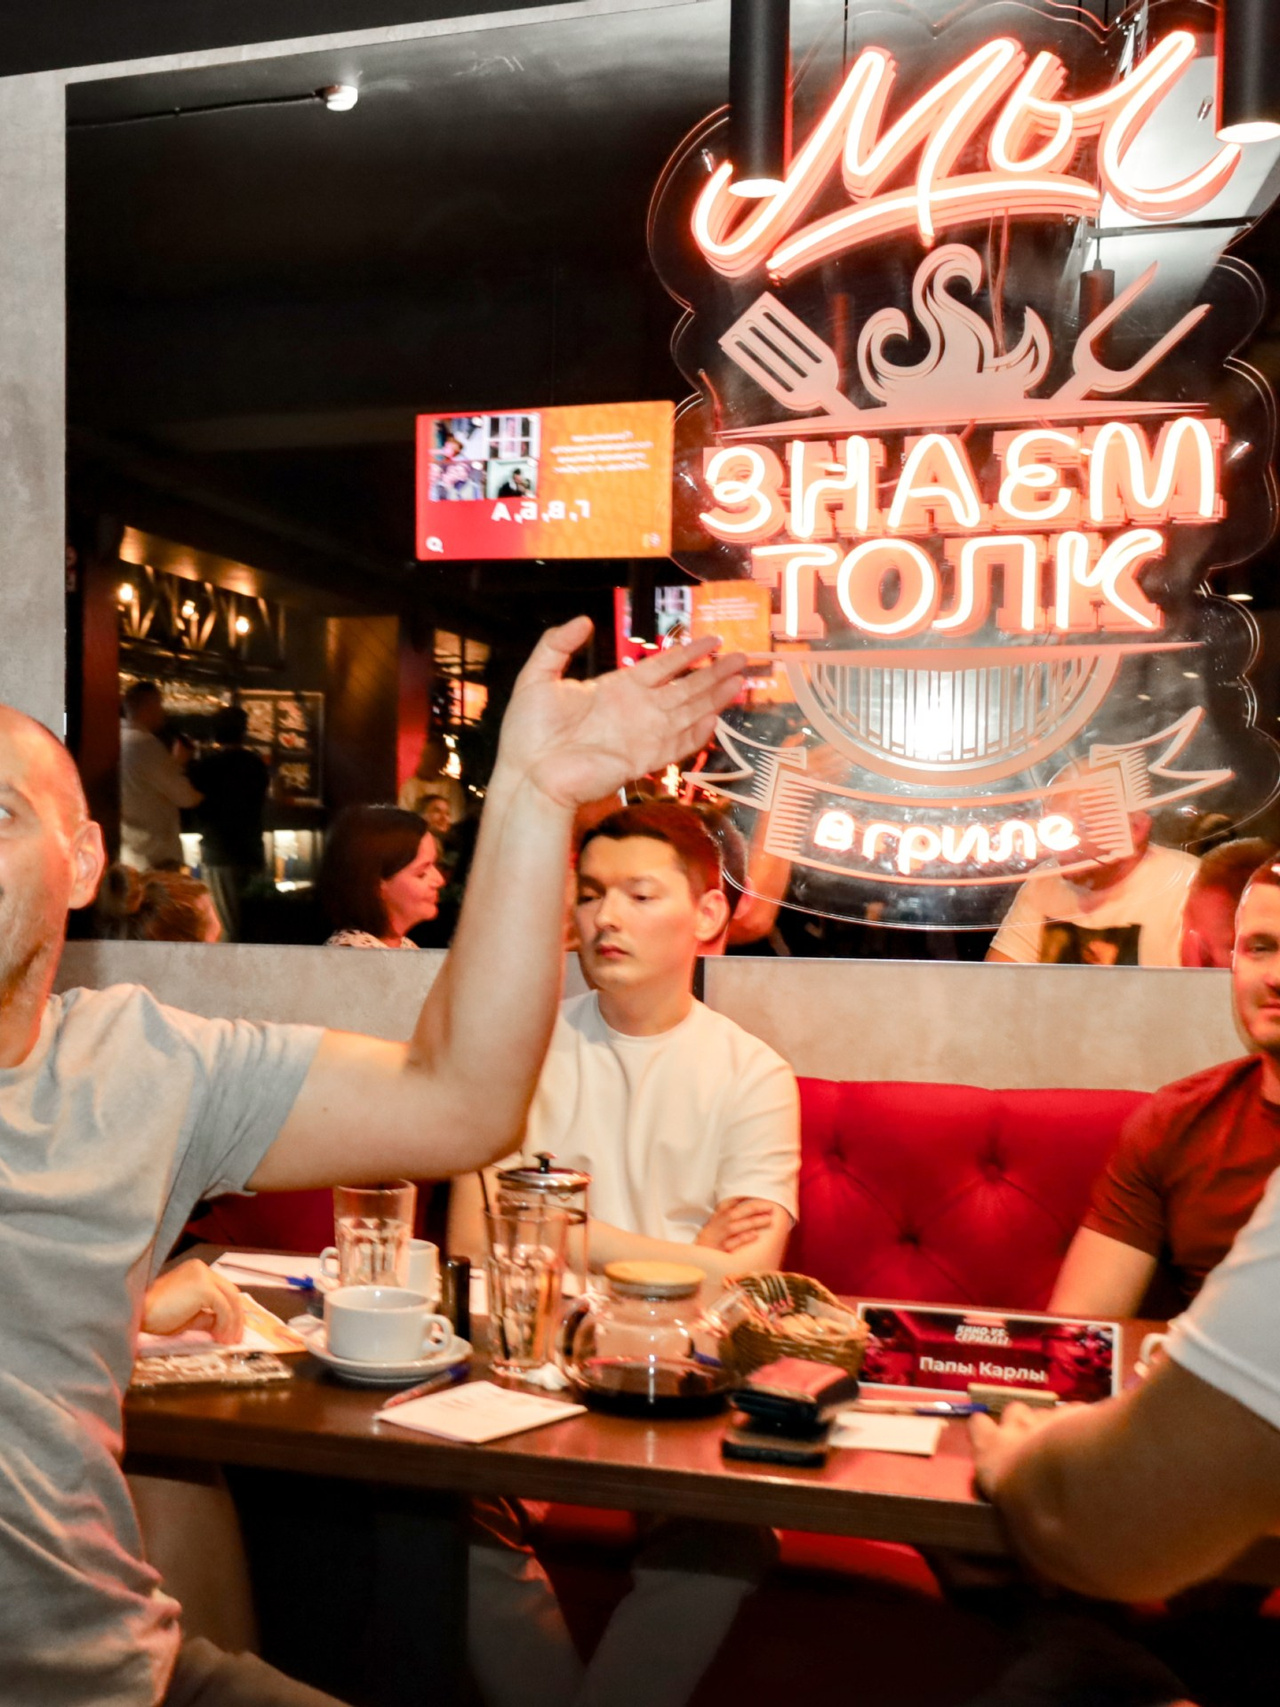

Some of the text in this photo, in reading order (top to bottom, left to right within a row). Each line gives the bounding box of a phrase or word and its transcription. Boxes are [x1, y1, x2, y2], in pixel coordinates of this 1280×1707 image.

[699, 416, 1225, 542] ЗНАЕМ
[750, 529, 1164, 638] ТОЛК
[860, 813, 1081, 876] гриле
[920, 1356, 1046, 1382] Папы Карлы
